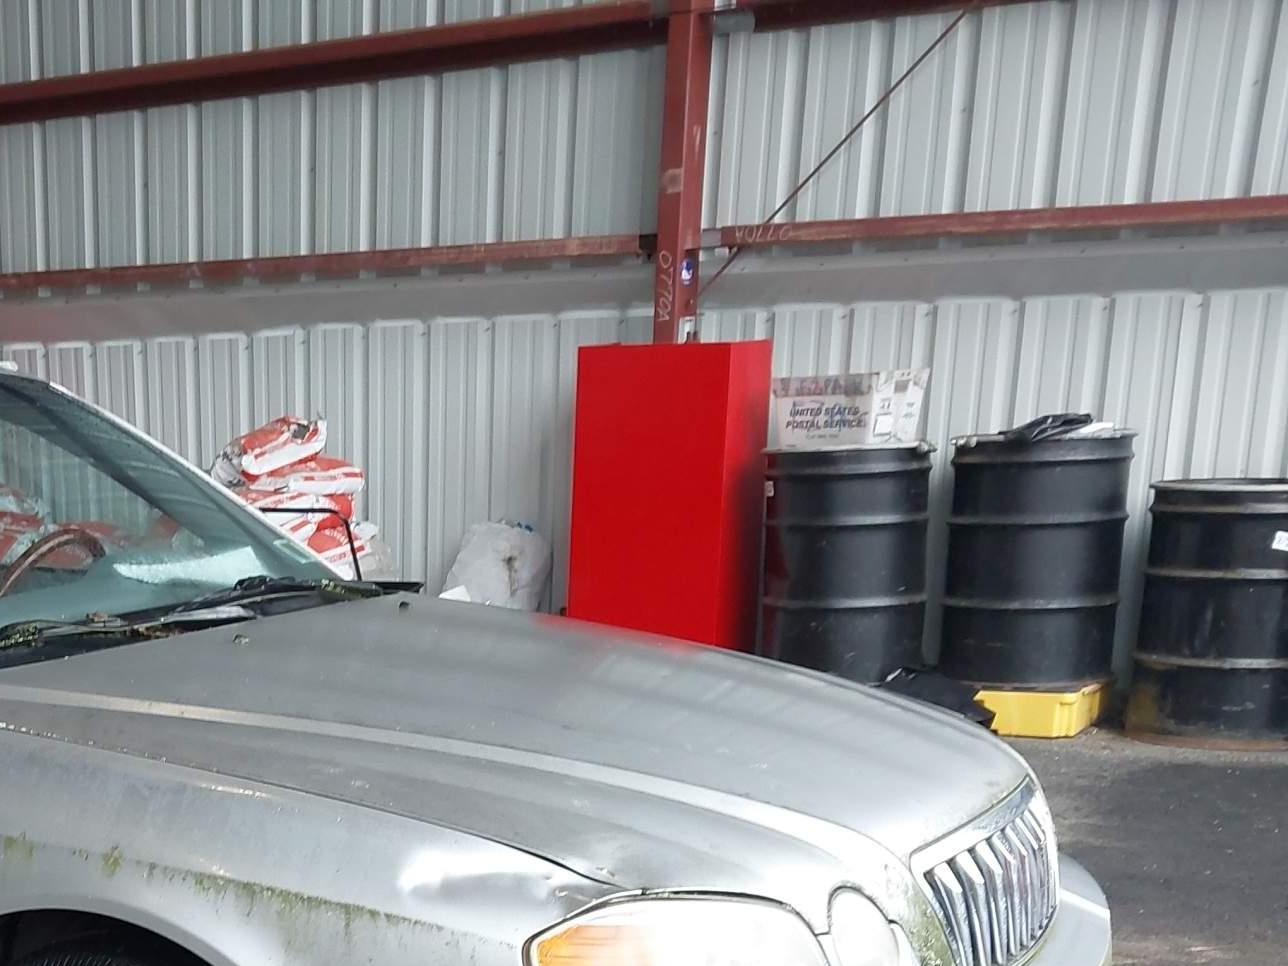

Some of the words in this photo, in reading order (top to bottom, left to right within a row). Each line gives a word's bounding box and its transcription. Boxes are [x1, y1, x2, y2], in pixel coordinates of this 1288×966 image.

[789, 406, 822, 417] UNITED
[823, 405, 860, 416] STATES
[785, 419, 821, 430] POSTAL
[823, 418, 864, 430] SERVICE
